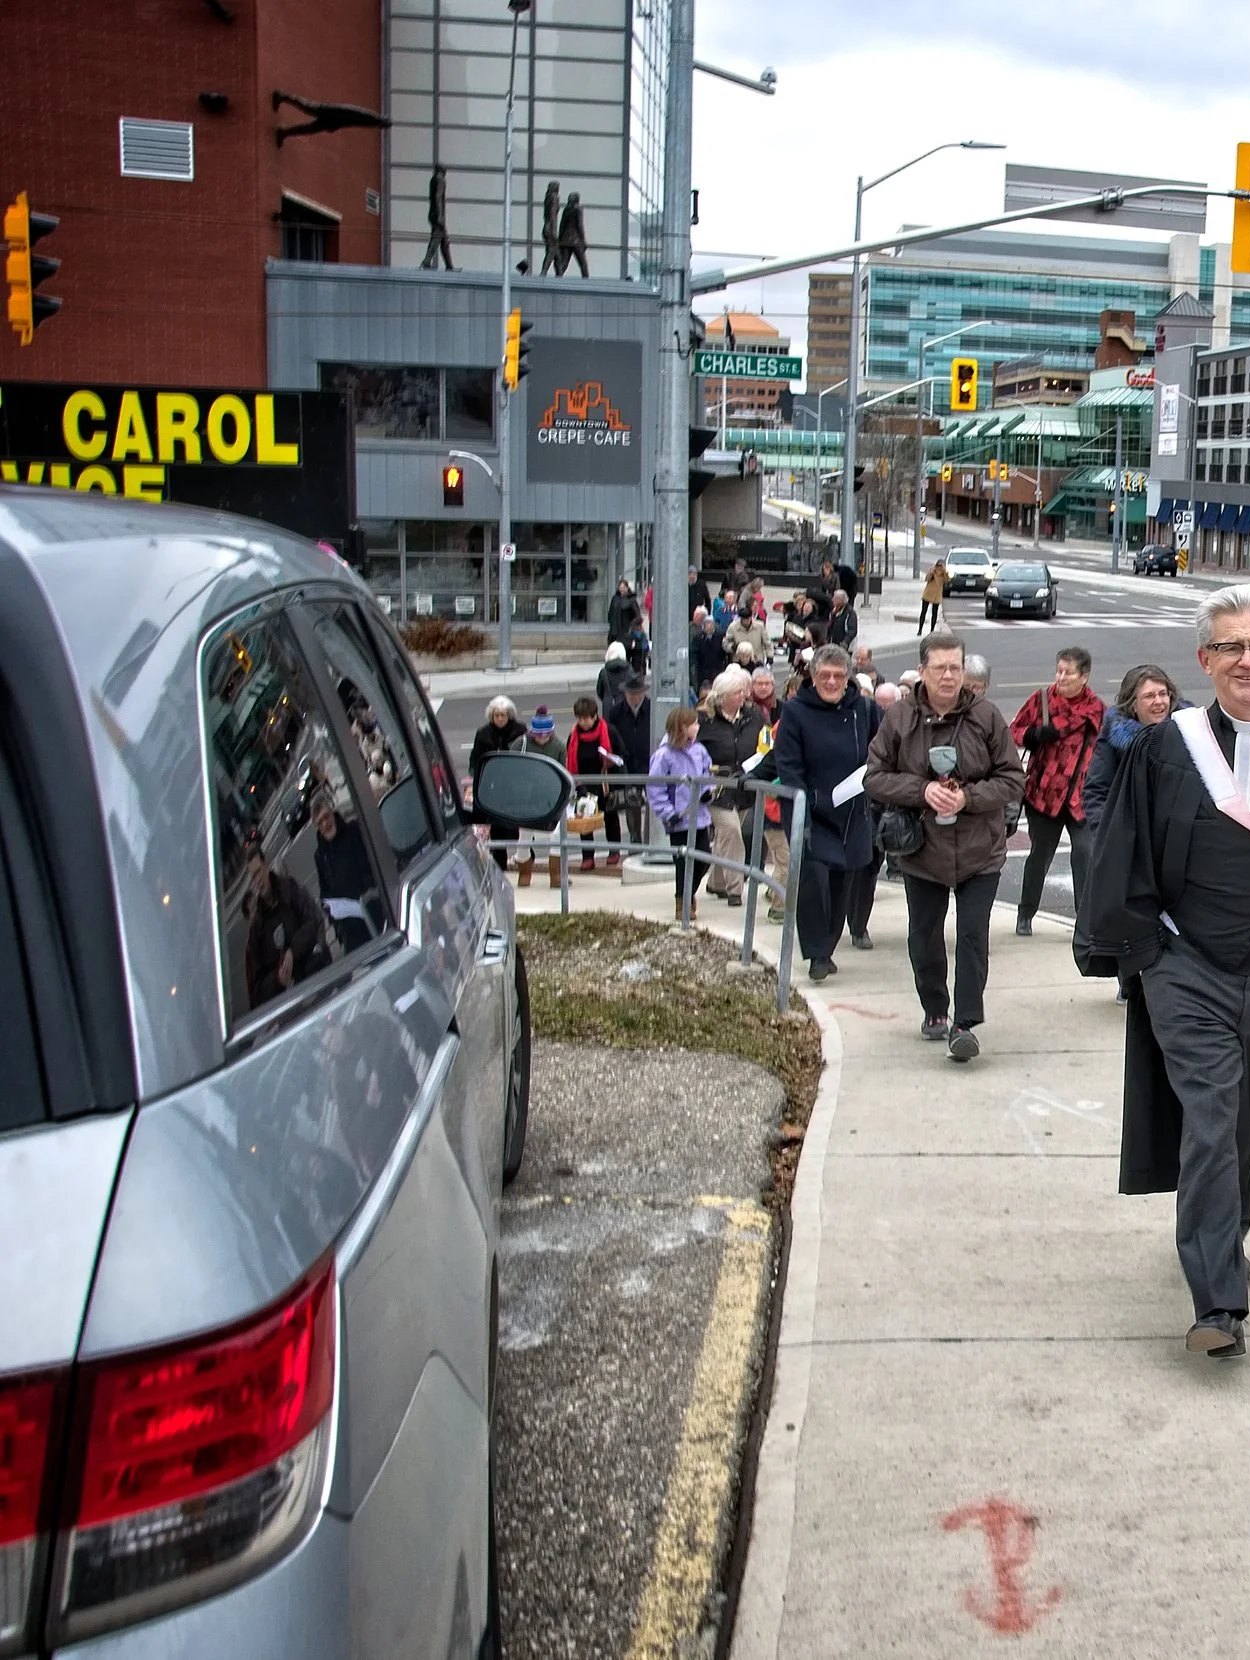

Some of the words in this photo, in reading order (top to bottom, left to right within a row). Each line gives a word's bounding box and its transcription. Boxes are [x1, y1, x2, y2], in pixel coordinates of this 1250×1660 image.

[700, 354, 778, 377] CHARLES
[62, 389, 299, 465] CAROL
[554, 419, 609, 429] DOWNTOWN
[538, 428, 586, 445] CREPE
[594, 430, 631, 447] CAFE
